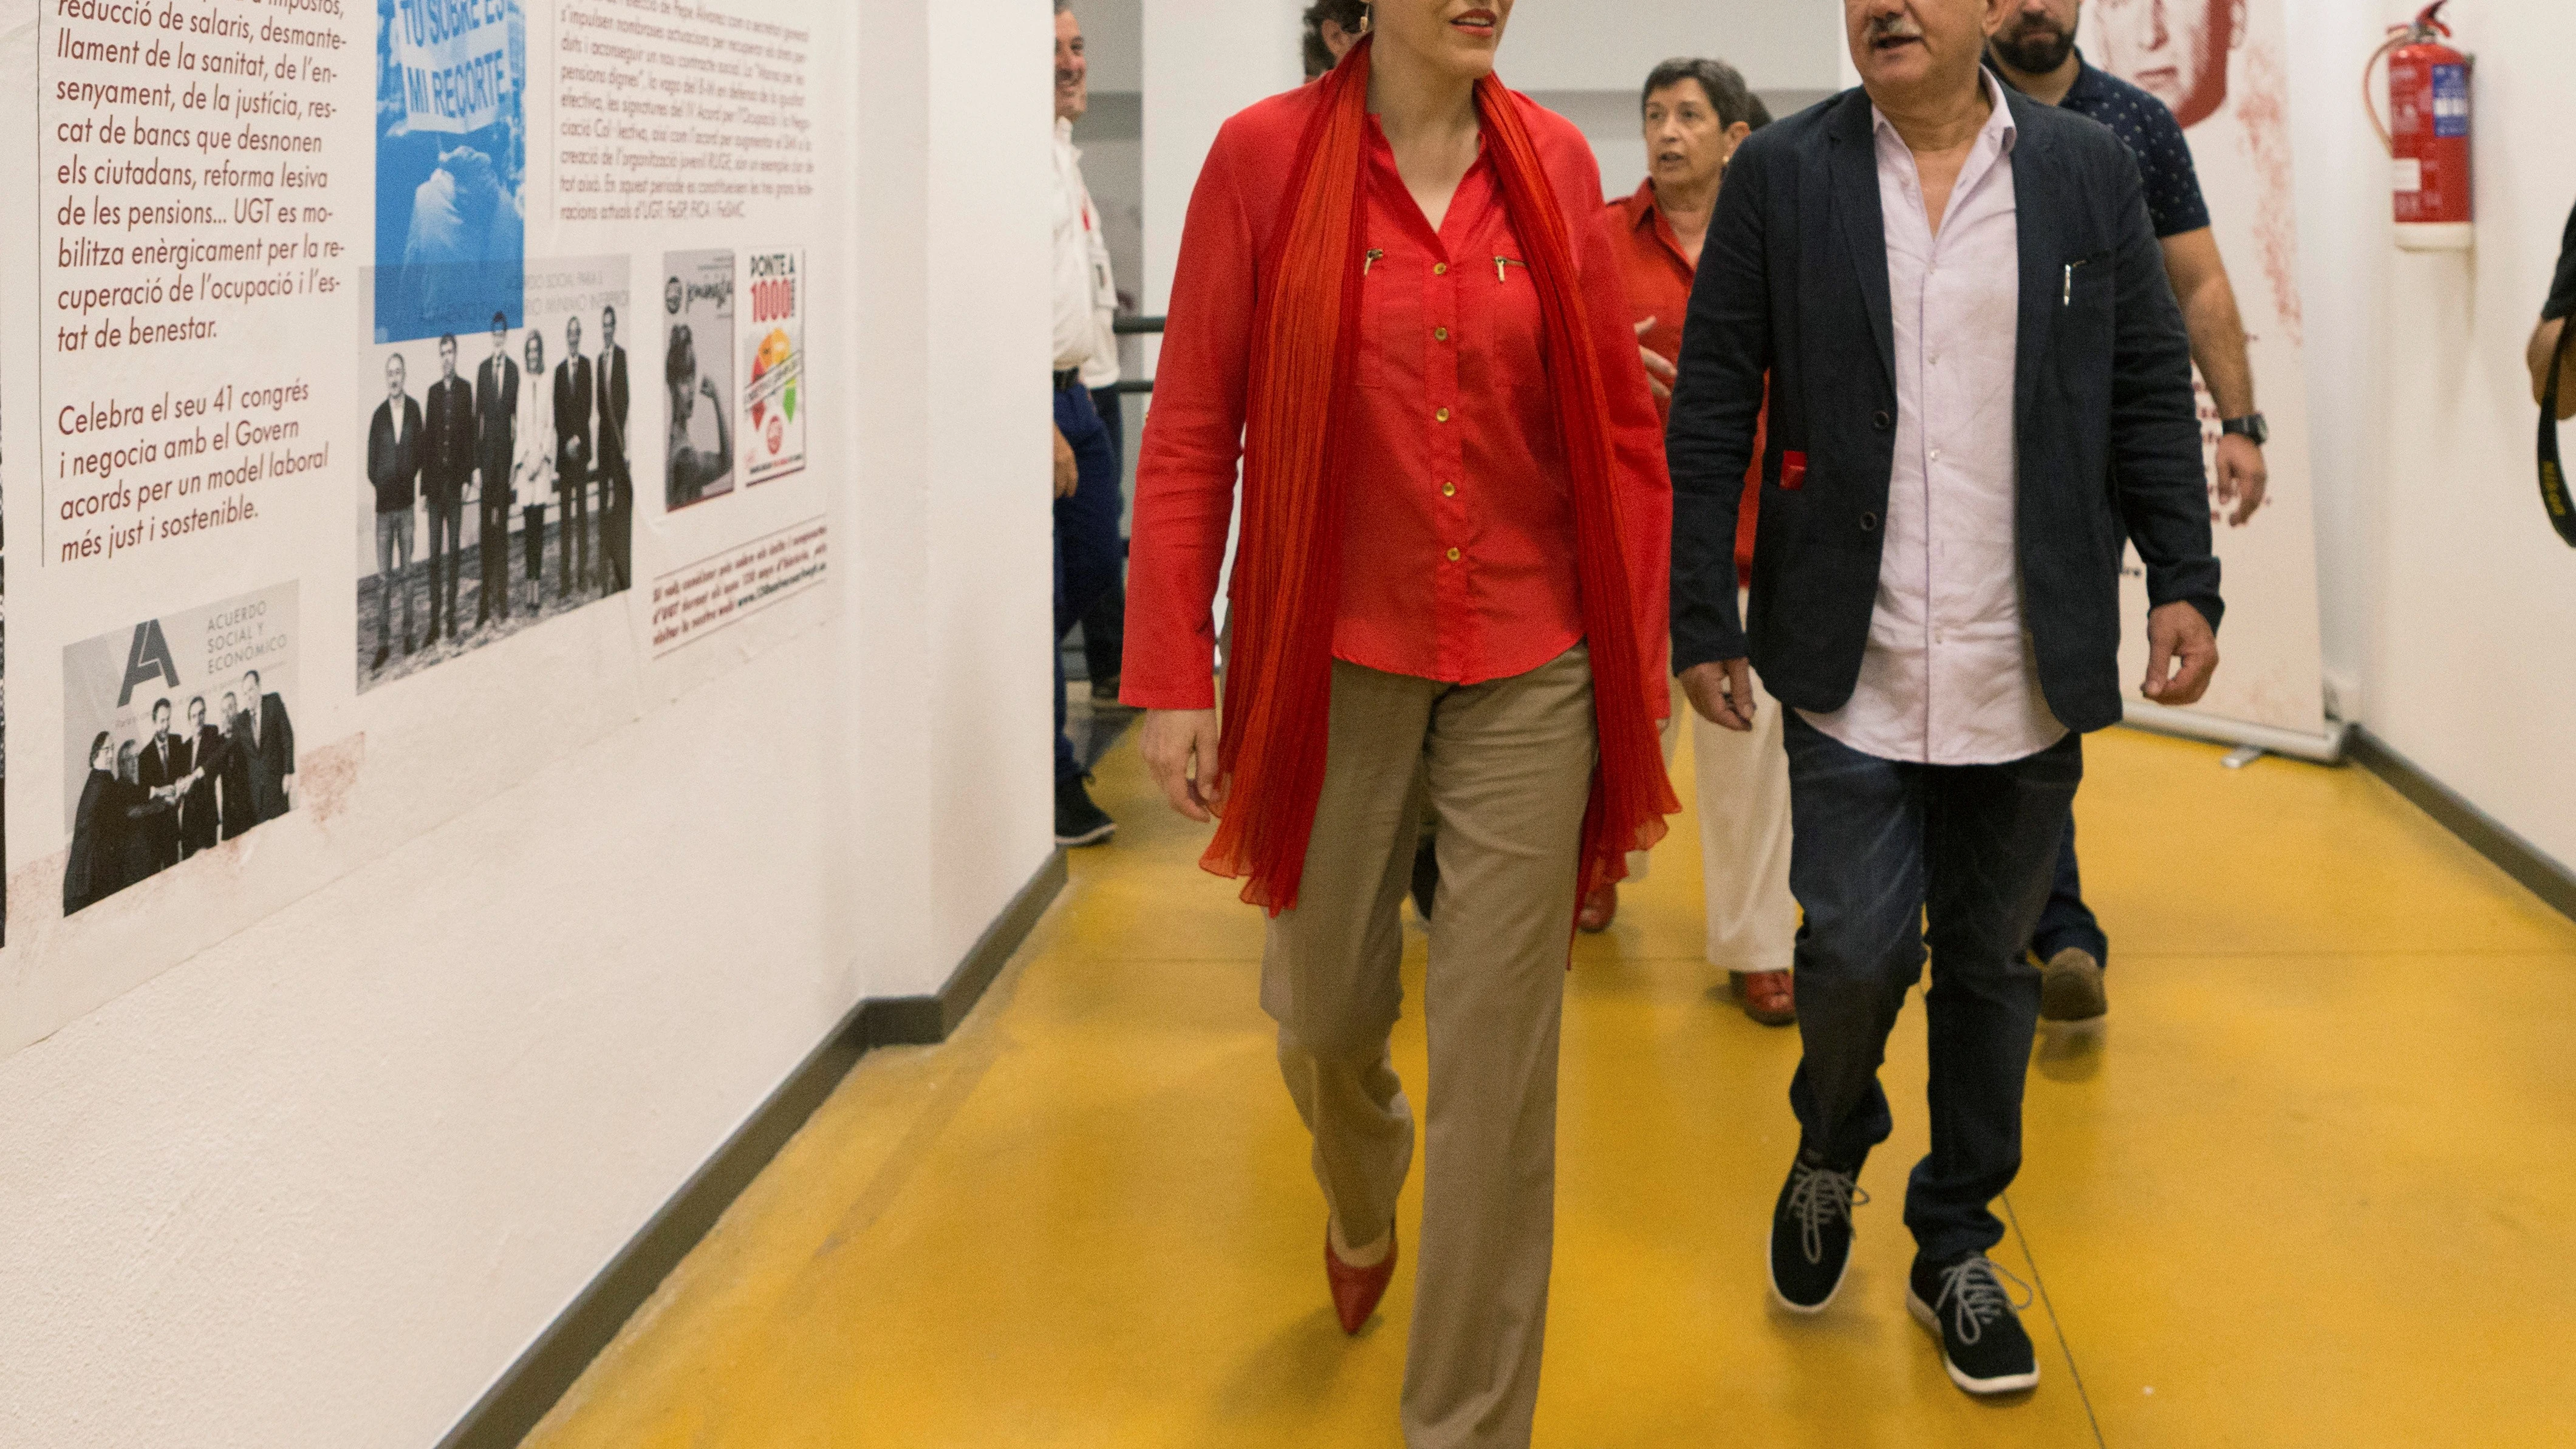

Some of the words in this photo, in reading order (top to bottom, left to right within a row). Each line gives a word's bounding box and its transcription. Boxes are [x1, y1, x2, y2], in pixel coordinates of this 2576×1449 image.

[57, 0, 152, 26] reducció
[159, 1, 183, 29] de
[190, 9, 253, 43] salaris,
[261, 16, 346, 49] desmante-
[58, 28, 139, 63] llament
[146, 39, 170, 67] de
[178, 41, 195, 70] la
[202, 53, 268, 81] sanitat,
[275, 56, 296, 80] de
[303, 56, 337, 83] l'en-
[56, 80, 176, 111] senyament,
[183, 81, 206, 109] de
[214, 84, 229, 111] la
[236, 84, 302, 119] justícia,
[309, 100, 337, 118] res-
[408, 67, 429, 113] MI
[432, 49, 504, 118] RECORTE
[58, 118, 92, 143] cat
[100, 115, 125, 144] de
[134, 116, 190, 147] bancs
[197, 129, 231, 154] que
[237, 123, 321, 152] desnonen
[59, 154, 86, 184] els
[94, 157, 196, 189] ciutadans,
[204, 159, 273, 187] reforma
[281, 162, 327, 188] lesiva
[58, 195, 85, 225] de
[94, 196, 120, 224] les
[128, 199, 227, 231] pensions...
[234, 199, 273, 223] UGT
[278, 203, 296, 223] es
[304, 203, 332, 223] mo-
[59, 237, 122, 267] bilitza
[132, 237, 261, 269] enèrgicament
[268, 240, 297, 265] per
[304, 233, 318, 258] la
[324, 242, 344, 258] re-
[59, 278, 162, 316] cuperació
[169, 274, 193, 301] de
[200, 271, 292, 303] l'ocupació
[299, 270, 303, 294] i
[309, 268, 340, 293] l'es-
[751, 279, 792, 322] 1000
[59, 327, 88, 352] tat
[95, 318, 121, 347] de
[129, 316, 217, 345] benestar.
[59, 400, 143, 435] Celebra
[151, 392, 168, 422] el
[175, 397, 205, 419] seu
[213, 385, 233, 412] 41
[241, 378, 309, 408] congrés
[60, 452, 64, 477] i
[73, 440, 156, 478] negocia
[165, 426, 206, 459] amb
[213, 422, 228, 449] el
[236, 418, 299, 446] Govern
[61, 480, 131, 520] acords
[138, 480, 172, 511] per
[179, 477, 200, 496] un
[208, 452, 263, 490] model
[269, 440, 328, 478] laboral
[62, 530, 101, 562] més
[109, 521, 143, 558] just
[150, 517, 154, 540] i
[162, 493, 258, 539] sostenible.
[208, 601, 267, 631] ACUERDO
[208, 626, 253, 653] SOCIAL
[258, 621, 264, 636] Y
[207, 633, 288, 674] ECONÓMICO
